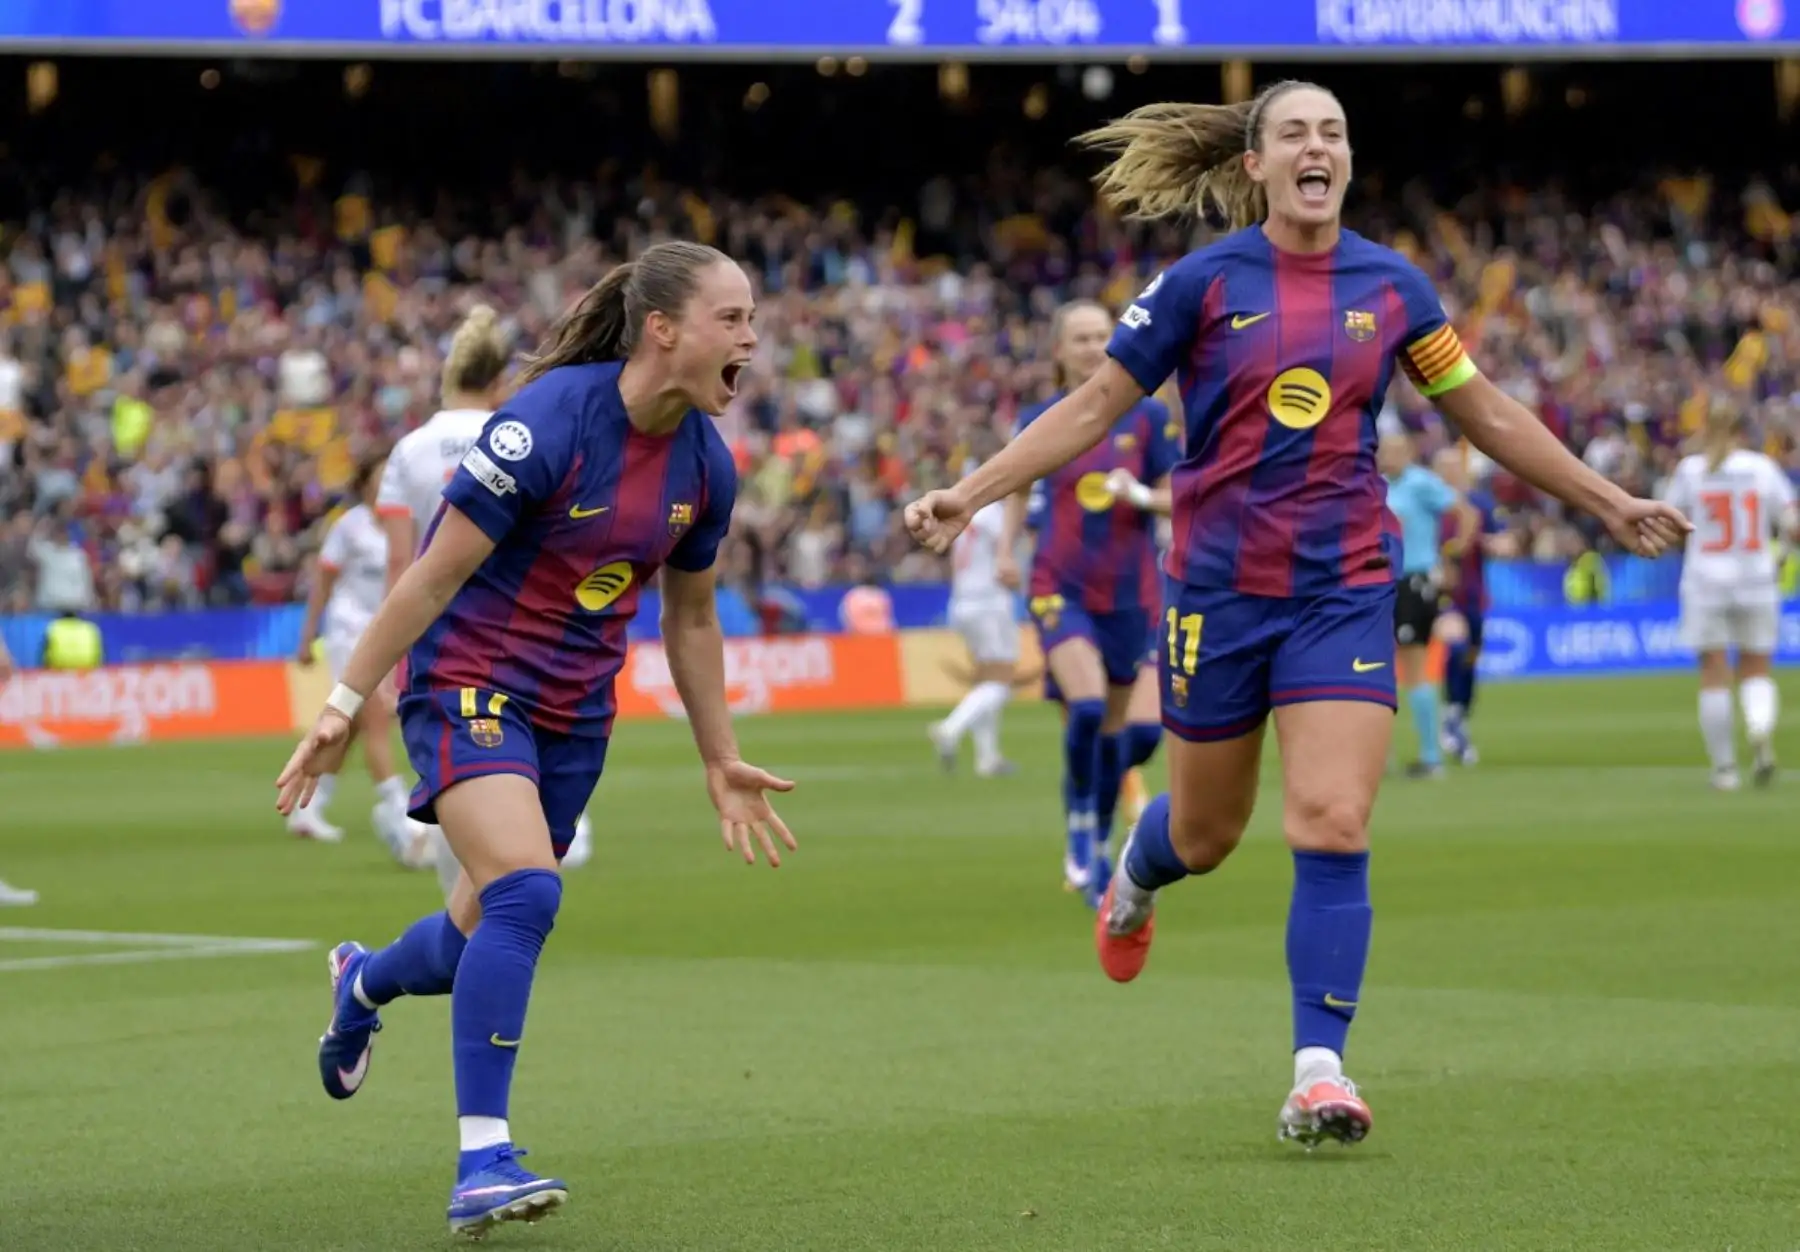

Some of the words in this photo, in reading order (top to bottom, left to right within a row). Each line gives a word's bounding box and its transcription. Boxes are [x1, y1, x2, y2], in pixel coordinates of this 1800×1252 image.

[441, 0, 717, 41] BARCELONA
[1699, 489, 1762, 551] 31
[1166, 606, 1203, 675] 11
